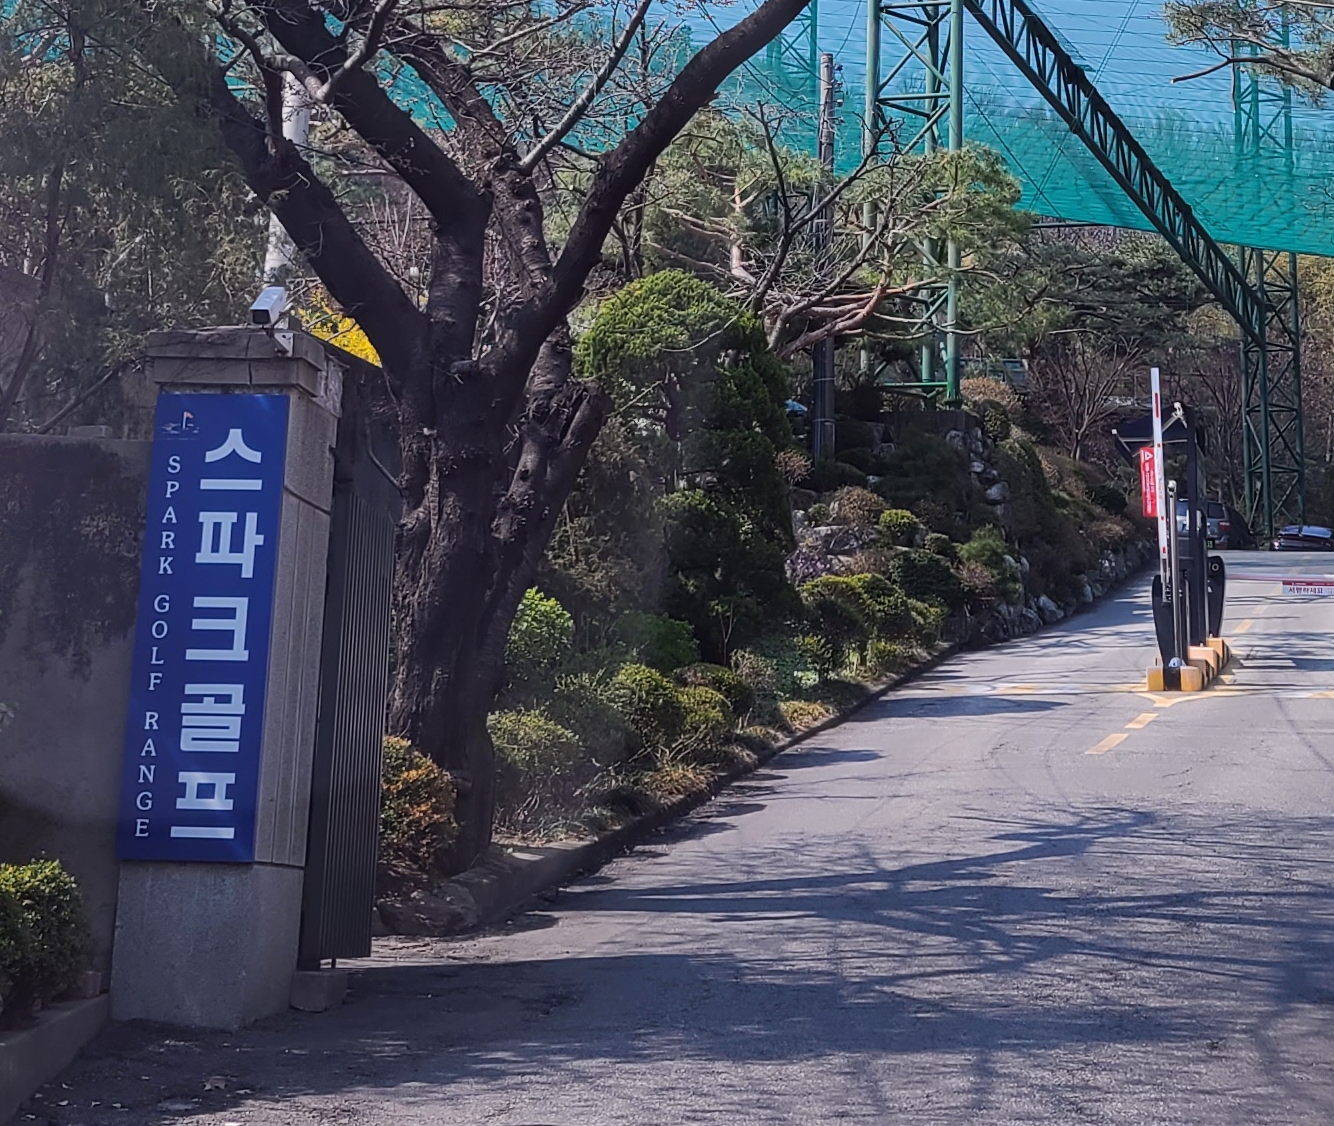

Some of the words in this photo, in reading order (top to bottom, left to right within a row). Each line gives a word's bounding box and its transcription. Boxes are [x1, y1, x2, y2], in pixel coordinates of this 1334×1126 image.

[158, 455, 181, 576] SPARK
[148, 594, 170, 692] GOLF
[170, 428, 264, 840] 스파크골프
[134, 711, 159, 838] RANGE
